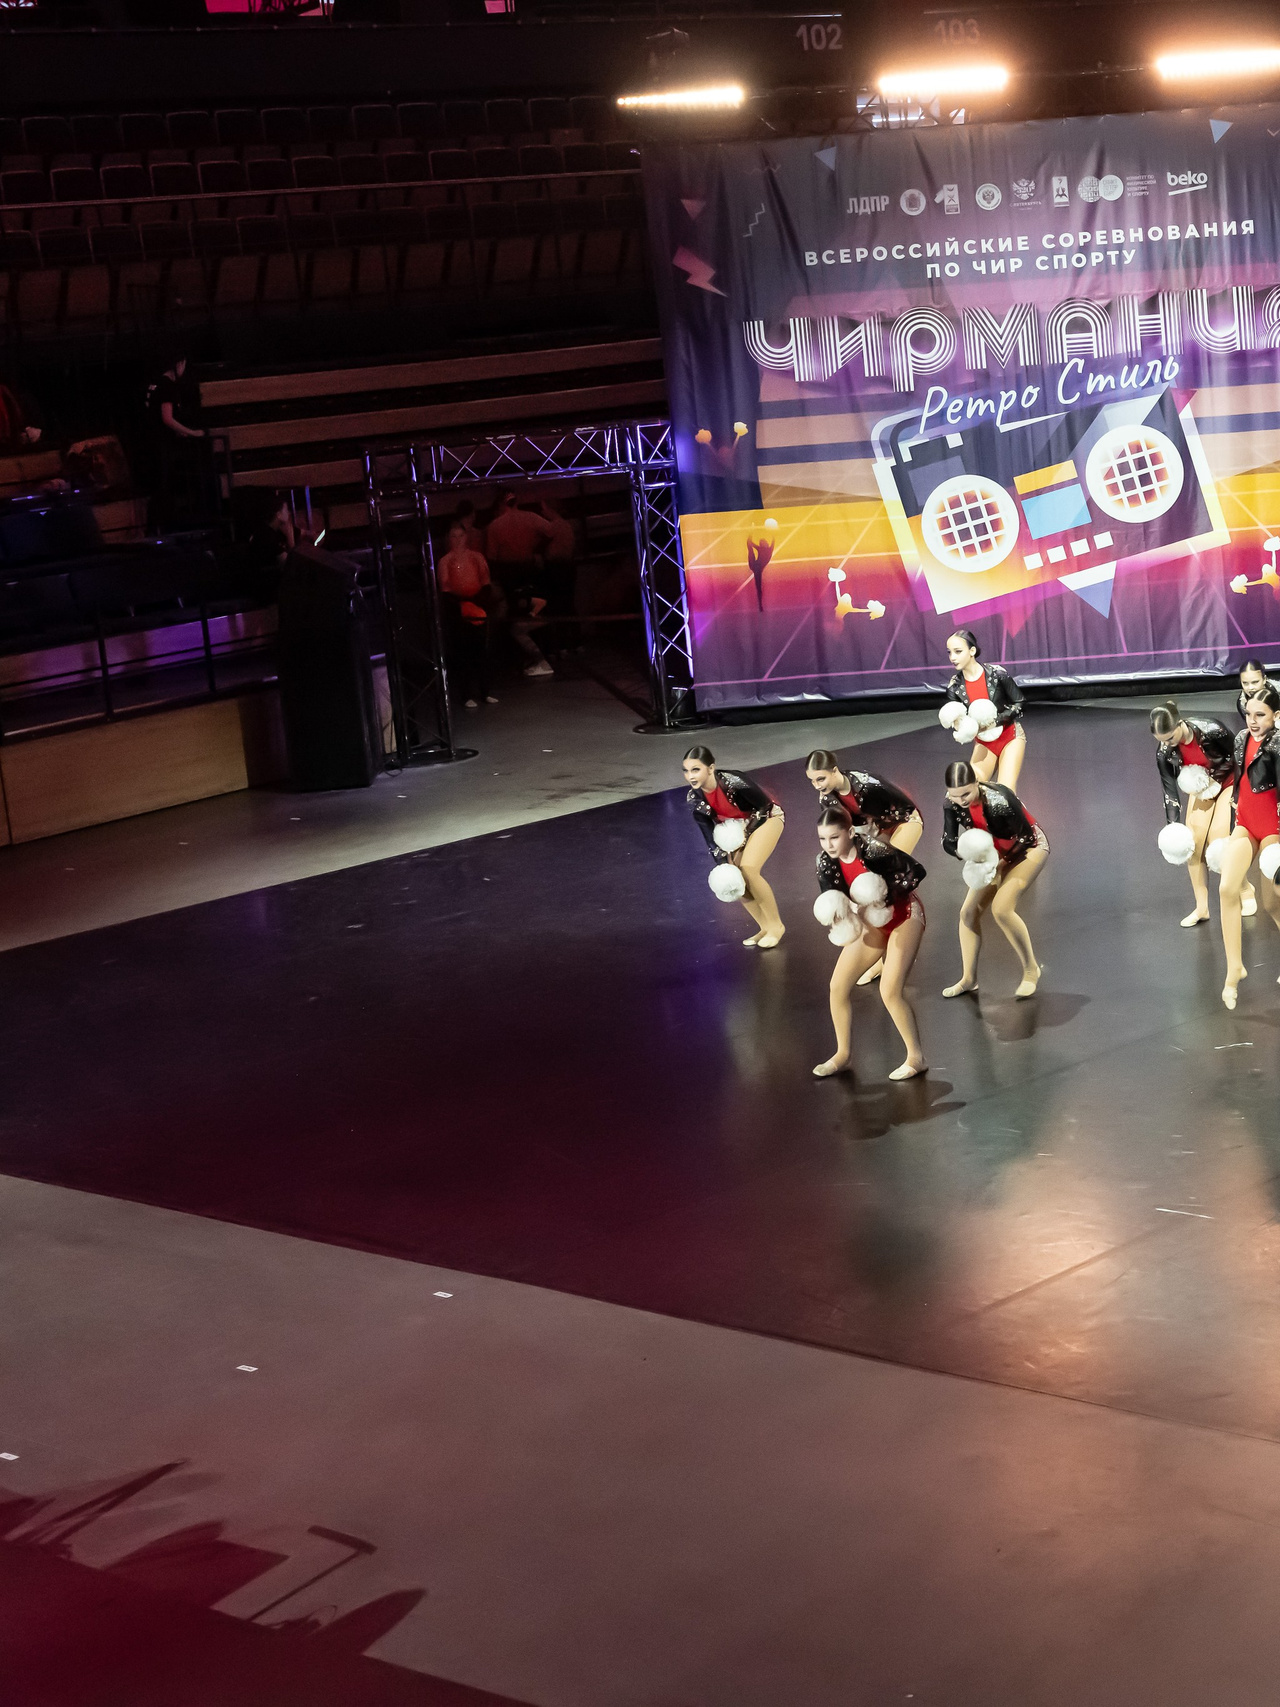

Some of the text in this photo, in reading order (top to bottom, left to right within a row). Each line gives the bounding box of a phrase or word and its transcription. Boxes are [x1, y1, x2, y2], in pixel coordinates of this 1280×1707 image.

[796, 23, 843, 51] 102
[935, 18, 981, 45] 103
[1166, 171, 1208, 186] beko
[847, 195, 890, 216] ЛДПР
[804, 219, 1256, 267] ВСЕРОССИЙСКИЕ СОРЕВНОВАНИЯ
[926, 249, 1138, 279] ПО ЧИР СПОРТУ
[919, 356, 1180, 434] Ретро Стиль
